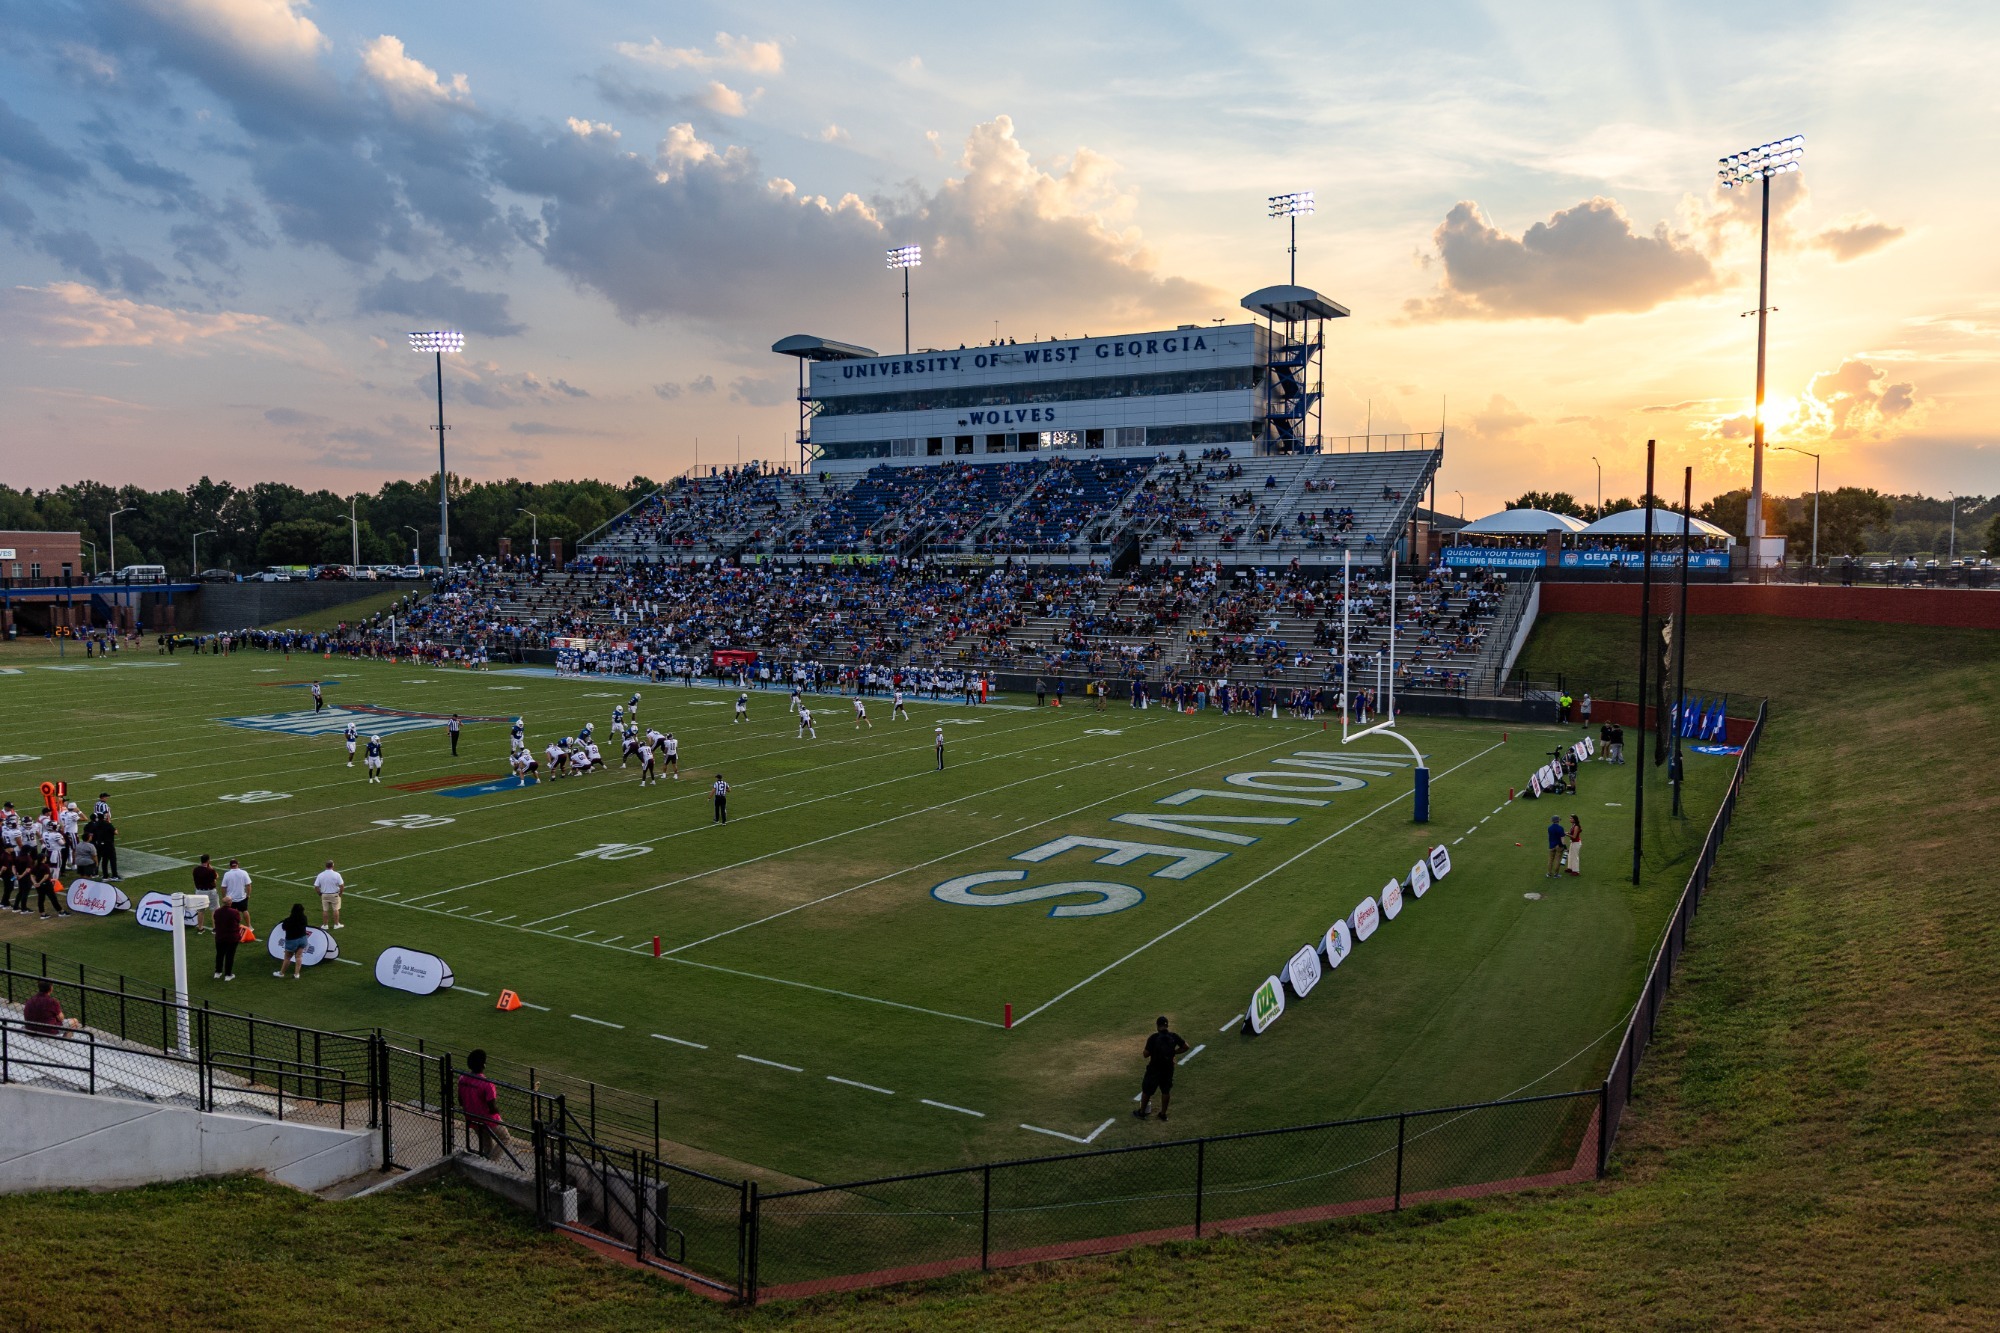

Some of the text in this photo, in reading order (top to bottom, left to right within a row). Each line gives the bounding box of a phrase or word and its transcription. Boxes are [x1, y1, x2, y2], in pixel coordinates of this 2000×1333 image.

[843, 336, 1206, 379] UNIVERSITY OF WEST GEORGIA
[970, 407, 1055, 426] WOLVES
[1446, 549, 1482, 557] QUENCH
[1584, 553, 1618, 561] GEAR
[1622, 554, 1639, 562] UP
[1508, 558, 1540, 566] GARDEN!
[55, 626, 70, 636] 25
[370, 814, 456, 829] 20
[930, 750, 1432, 918] WOLVES
[574, 843, 654, 861] 10
[73, 883, 106, 911] Chick-fil-A
[499, 991, 511, 1008] G
[1256, 981, 1278, 1020] OZA
